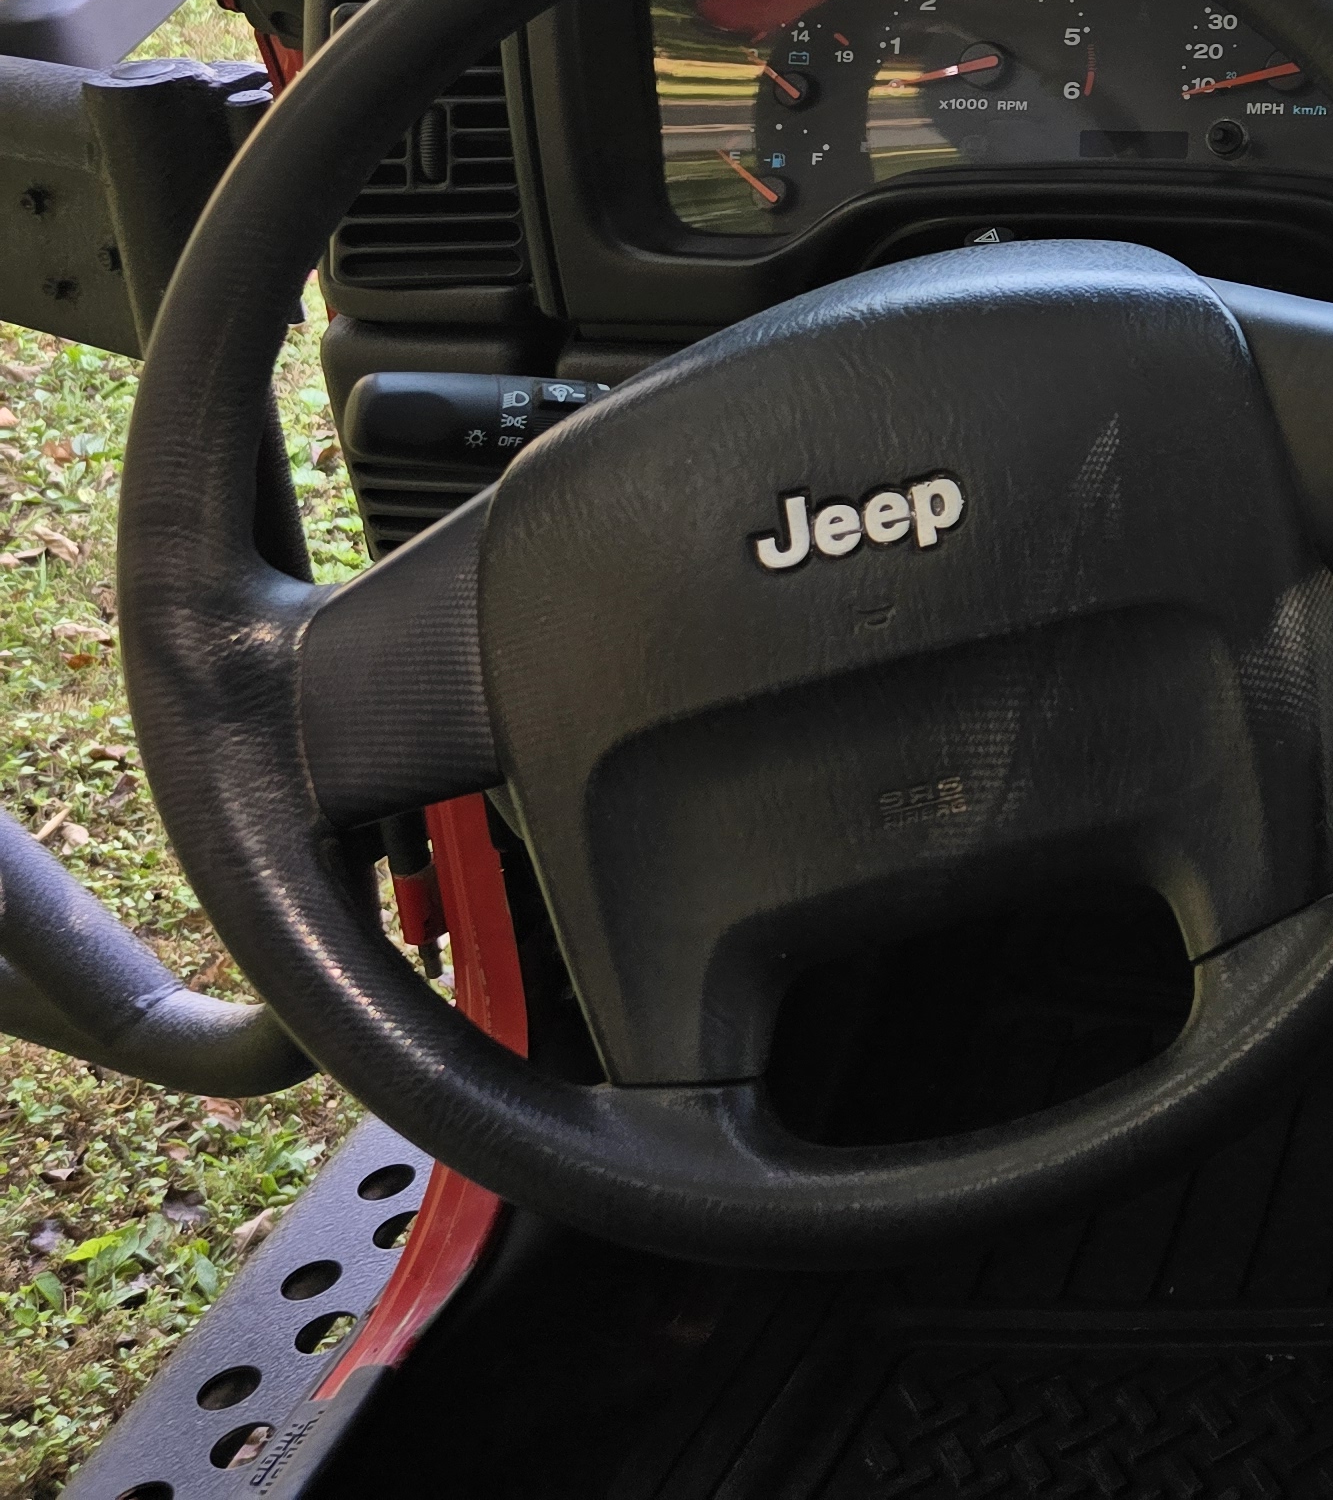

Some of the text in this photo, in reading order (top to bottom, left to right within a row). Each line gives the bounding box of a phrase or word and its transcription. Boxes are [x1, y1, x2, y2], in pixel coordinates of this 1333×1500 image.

[1207, 13, 1238, 30] 30
[791, 30, 810, 43] 14
[1063, 27, 1081, 46] 5
[889, 37, 901, 55] 1
[1192, 43, 1224, 59] 20
[834, 50, 854, 63] 19
[1063, 82, 1081, 100] 6
[938, 99, 1028, 111] x1000 RPM
[1246, 102, 1327, 116] MPH km/h
[811, 152, 823, 165] F
[498, 435, 524, 447] OFF
[755, 477, 965, 570] Jeep
